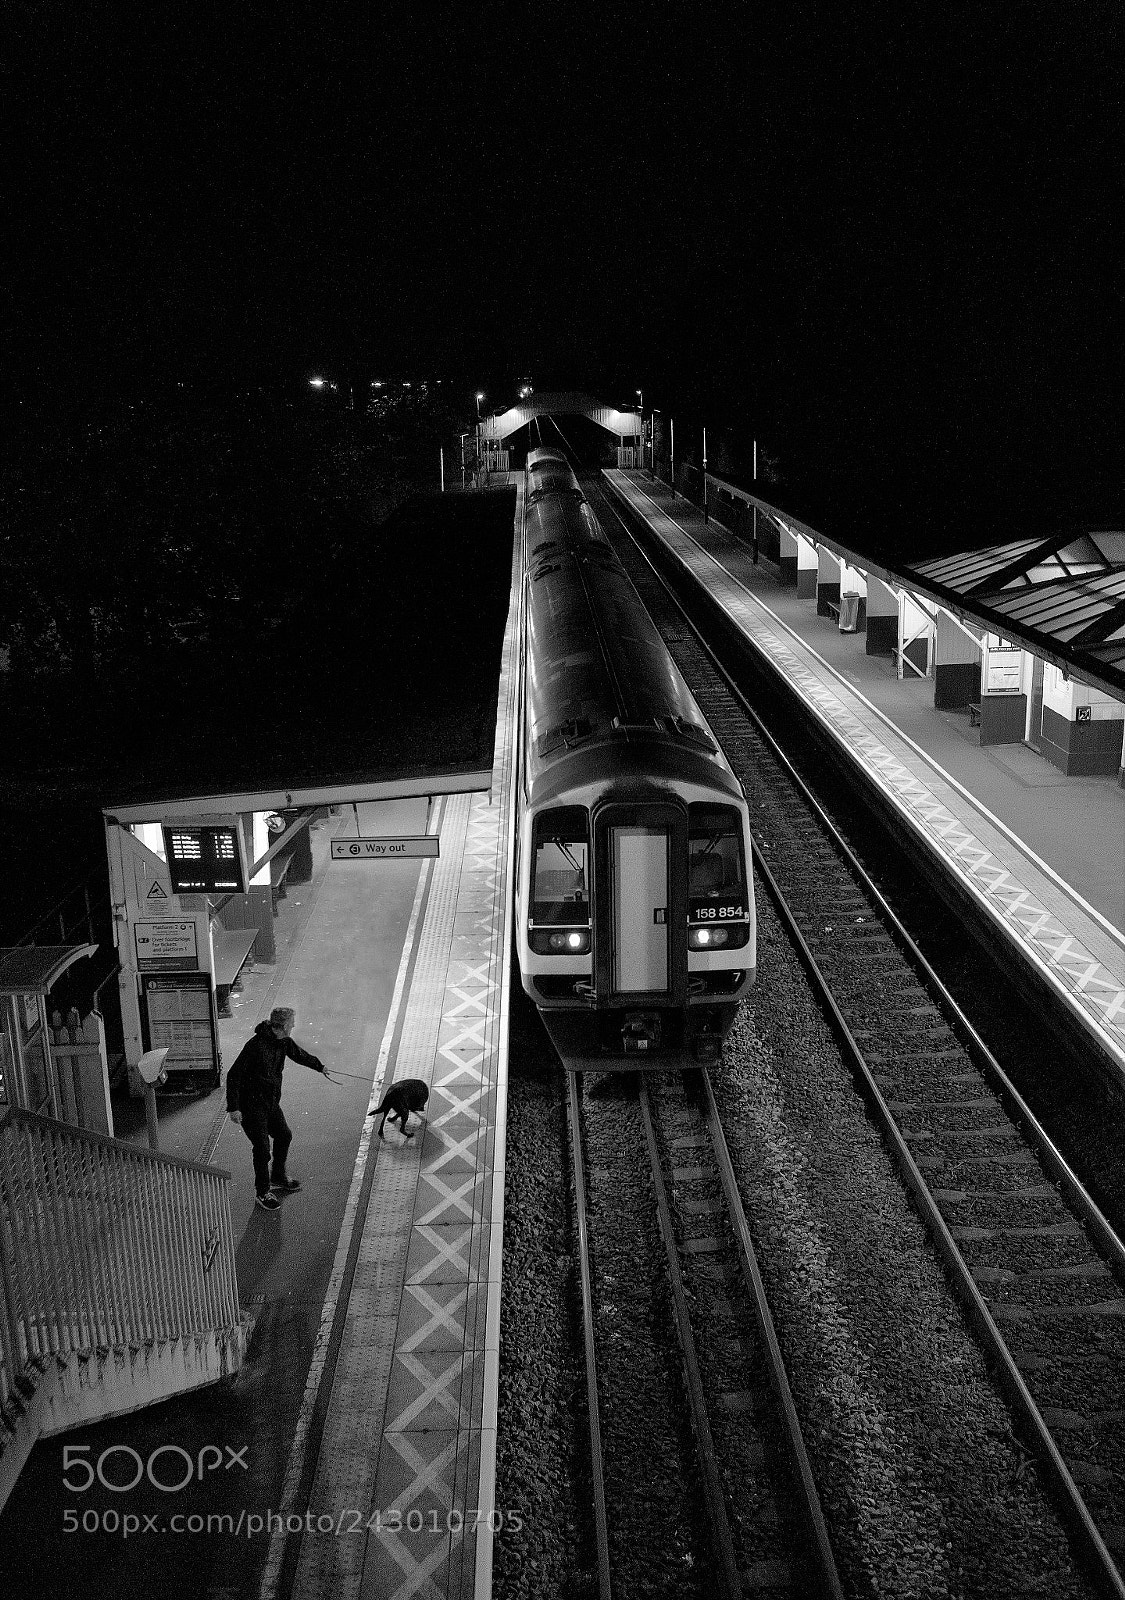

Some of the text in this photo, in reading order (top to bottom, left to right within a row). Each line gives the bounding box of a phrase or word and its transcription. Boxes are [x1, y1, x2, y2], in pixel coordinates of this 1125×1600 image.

[365, 843, 406, 854] Way out
[695, 906, 744, 919] 158 854
[732, 971, 741, 982] 7
